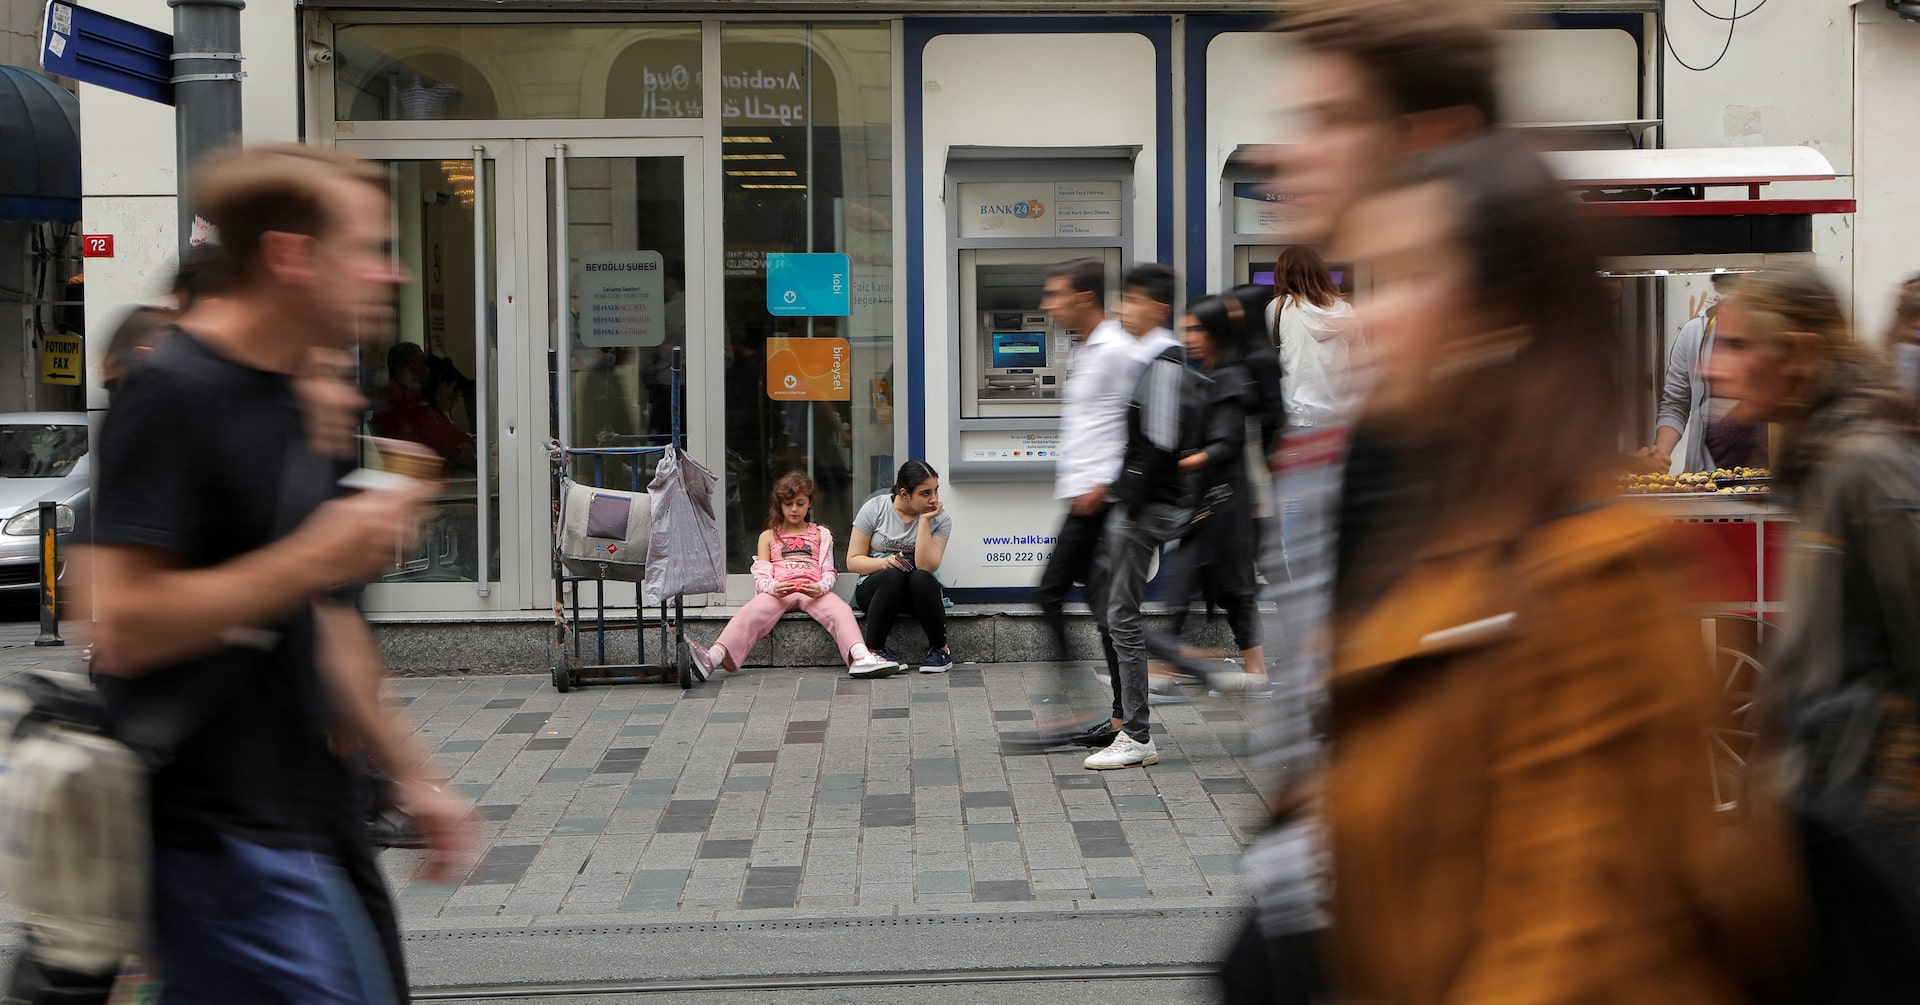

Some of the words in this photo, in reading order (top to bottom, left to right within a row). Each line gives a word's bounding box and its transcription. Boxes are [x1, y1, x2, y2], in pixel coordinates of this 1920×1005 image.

[1265, 193, 1276, 201] 24
[980, 205, 1012, 215] BANK
[90, 239, 106, 251] 72
[586, 262, 625, 271] BEYOĞLU
[626, 261, 657, 272] ŞUBESİ
[833, 273, 842, 295] kobi
[45, 339, 79, 354] FOTOKOPİ
[53, 357, 69, 369] FAX
[831, 346, 843, 391] bireysel
[983, 535, 1061, 545] www.halkban
[986, 552, 1012, 562] 0850
[1014, 552, 1034, 562] 222
[1036, 552, 1043, 561] 0
